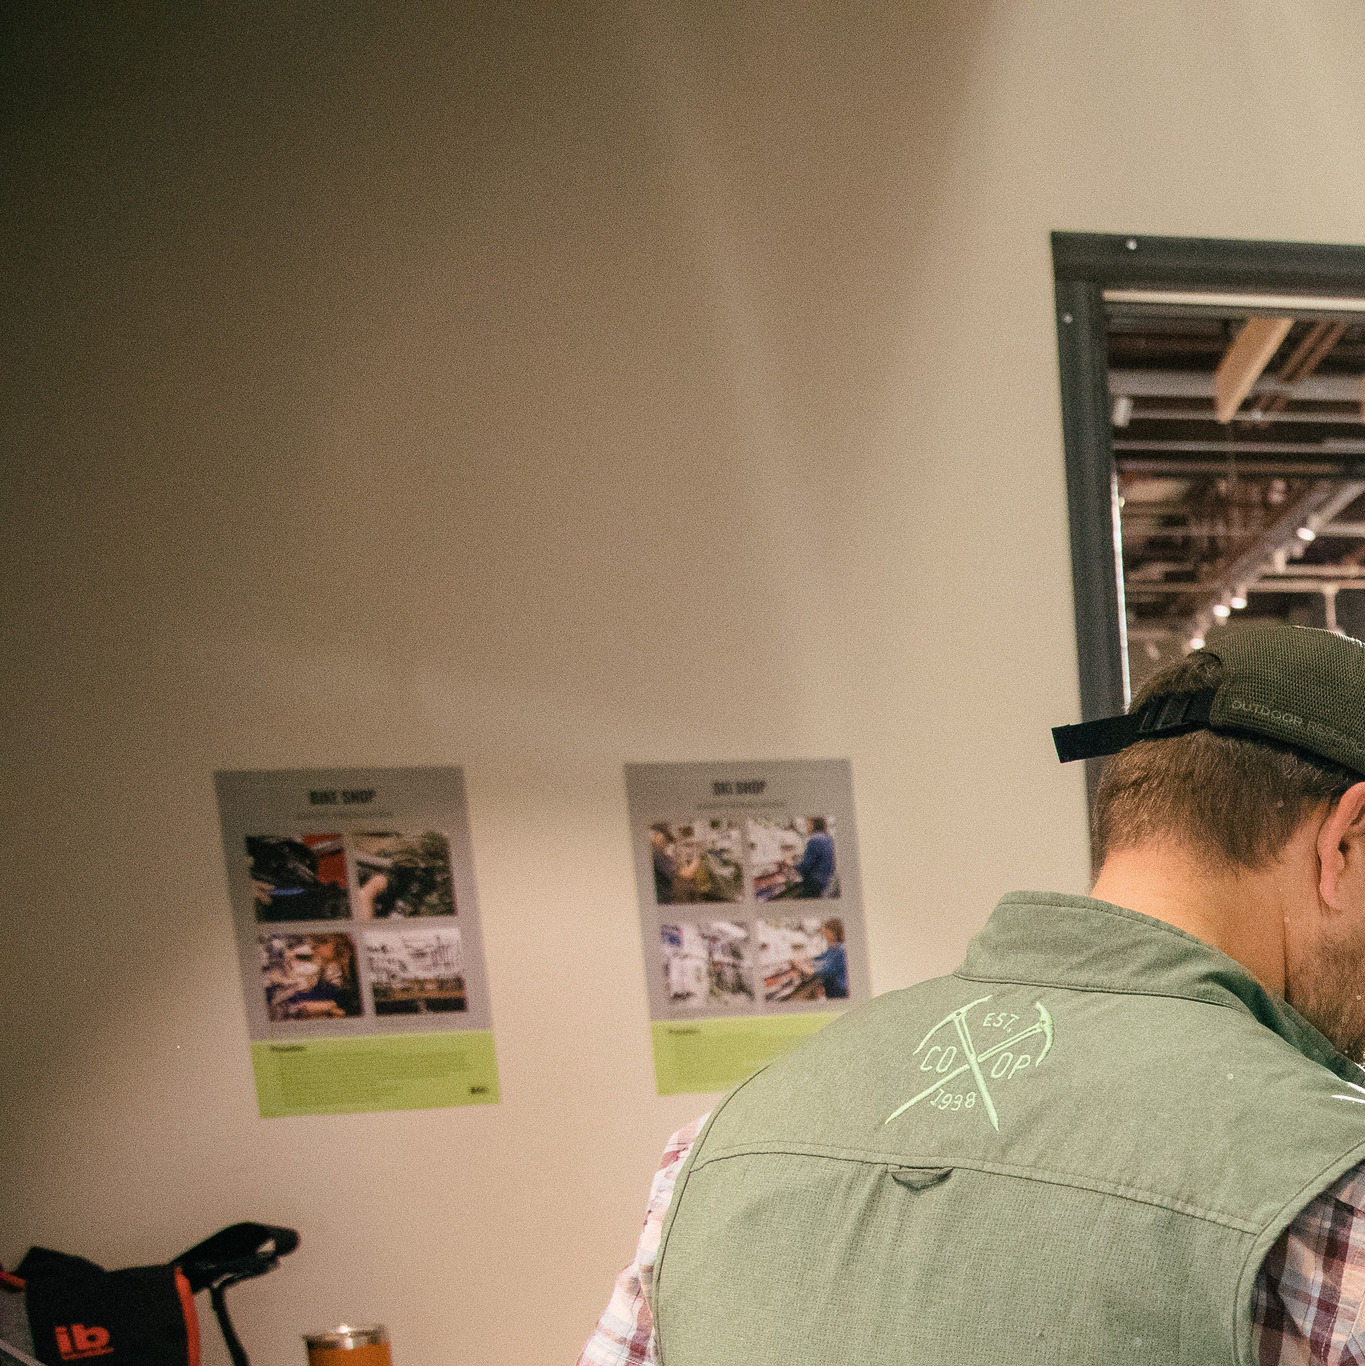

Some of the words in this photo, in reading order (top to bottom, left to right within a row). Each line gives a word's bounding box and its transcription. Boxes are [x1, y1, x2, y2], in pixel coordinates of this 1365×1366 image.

[1232, 700, 1302, 724] OUTDOOR
[309, 790, 337, 805] BIKE
[342, 789, 374, 803] SHOP
[736, 780, 765, 794] SHOP
[983, 1013, 1019, 1032] EST.
[920, 1046, 956, 1073] CO
[991, 1052, 1031, 1080] OP
[930, 1088, 976, 1111] 1938
